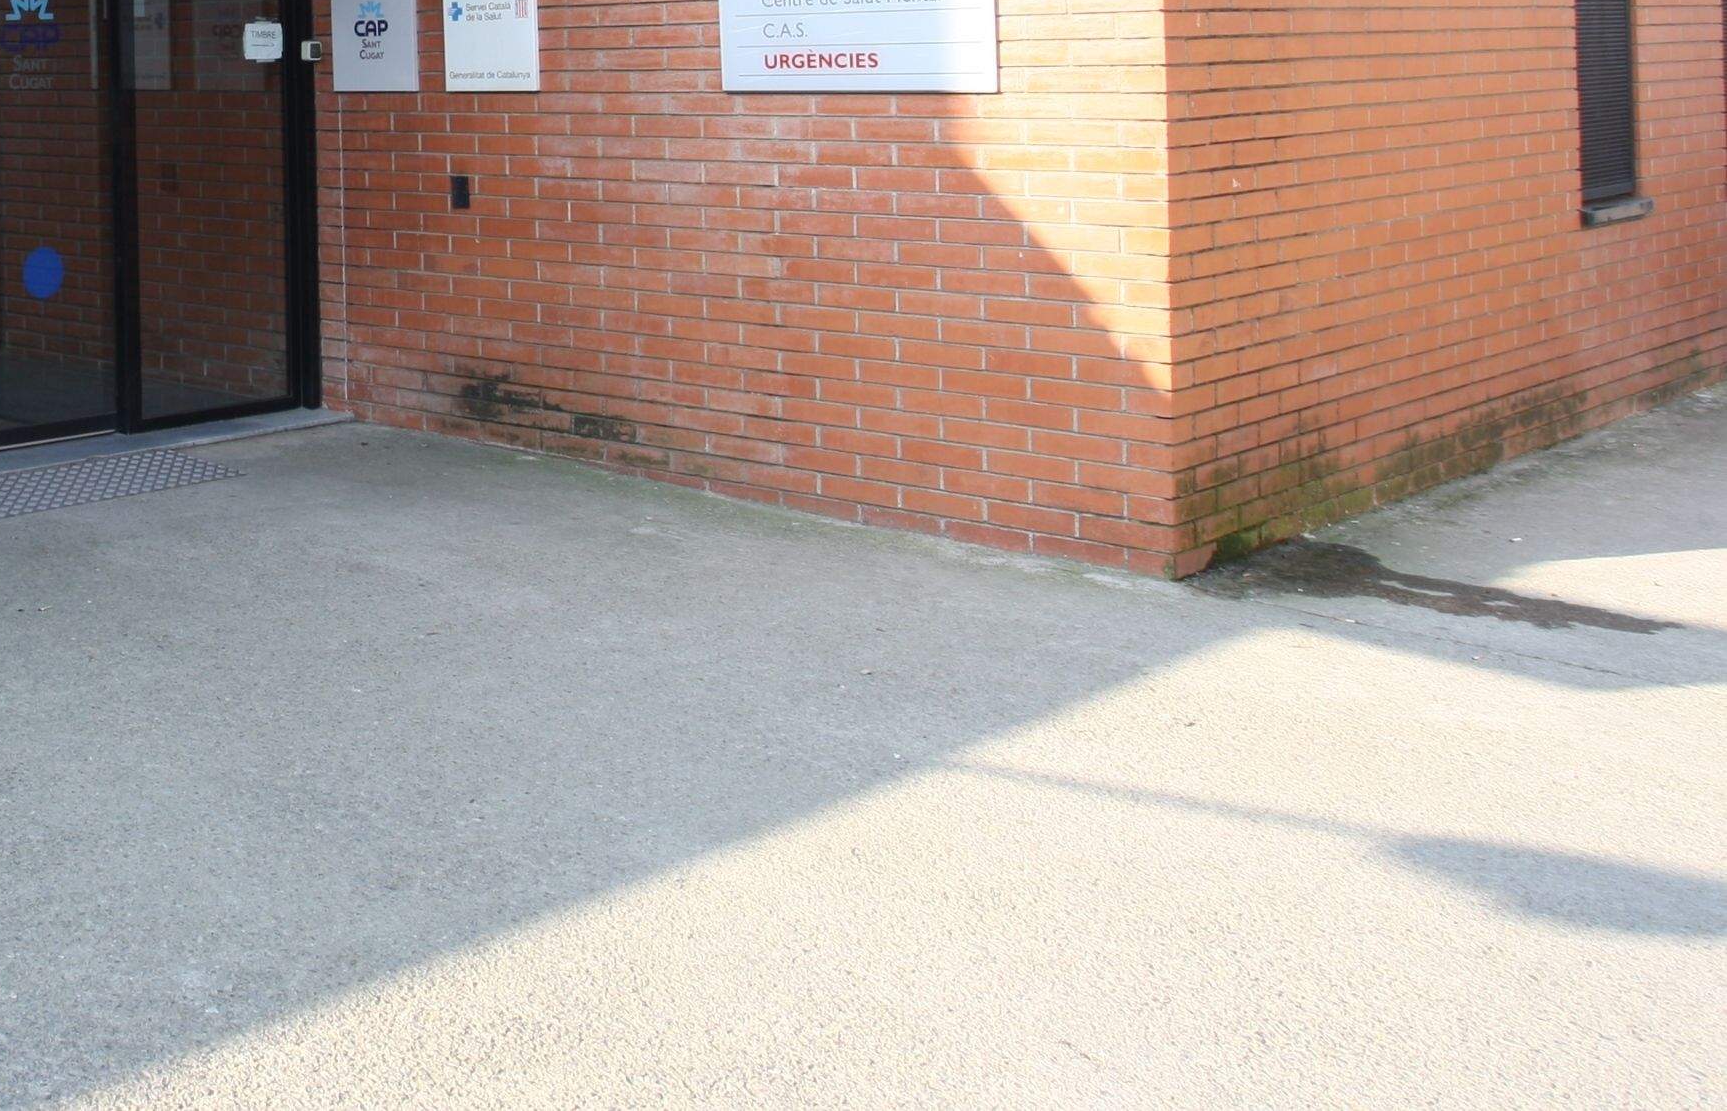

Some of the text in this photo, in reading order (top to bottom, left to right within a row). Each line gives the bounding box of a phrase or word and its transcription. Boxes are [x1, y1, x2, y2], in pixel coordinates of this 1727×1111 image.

[251, 30, 277, 40] TIMBRE
[354, 19, 388, 37] CAP
[763, 22, 808, 38] C.A.S.
[1, 24, 59, 54] CAP
[764, 49, 879, 69] URGÈNCIES
